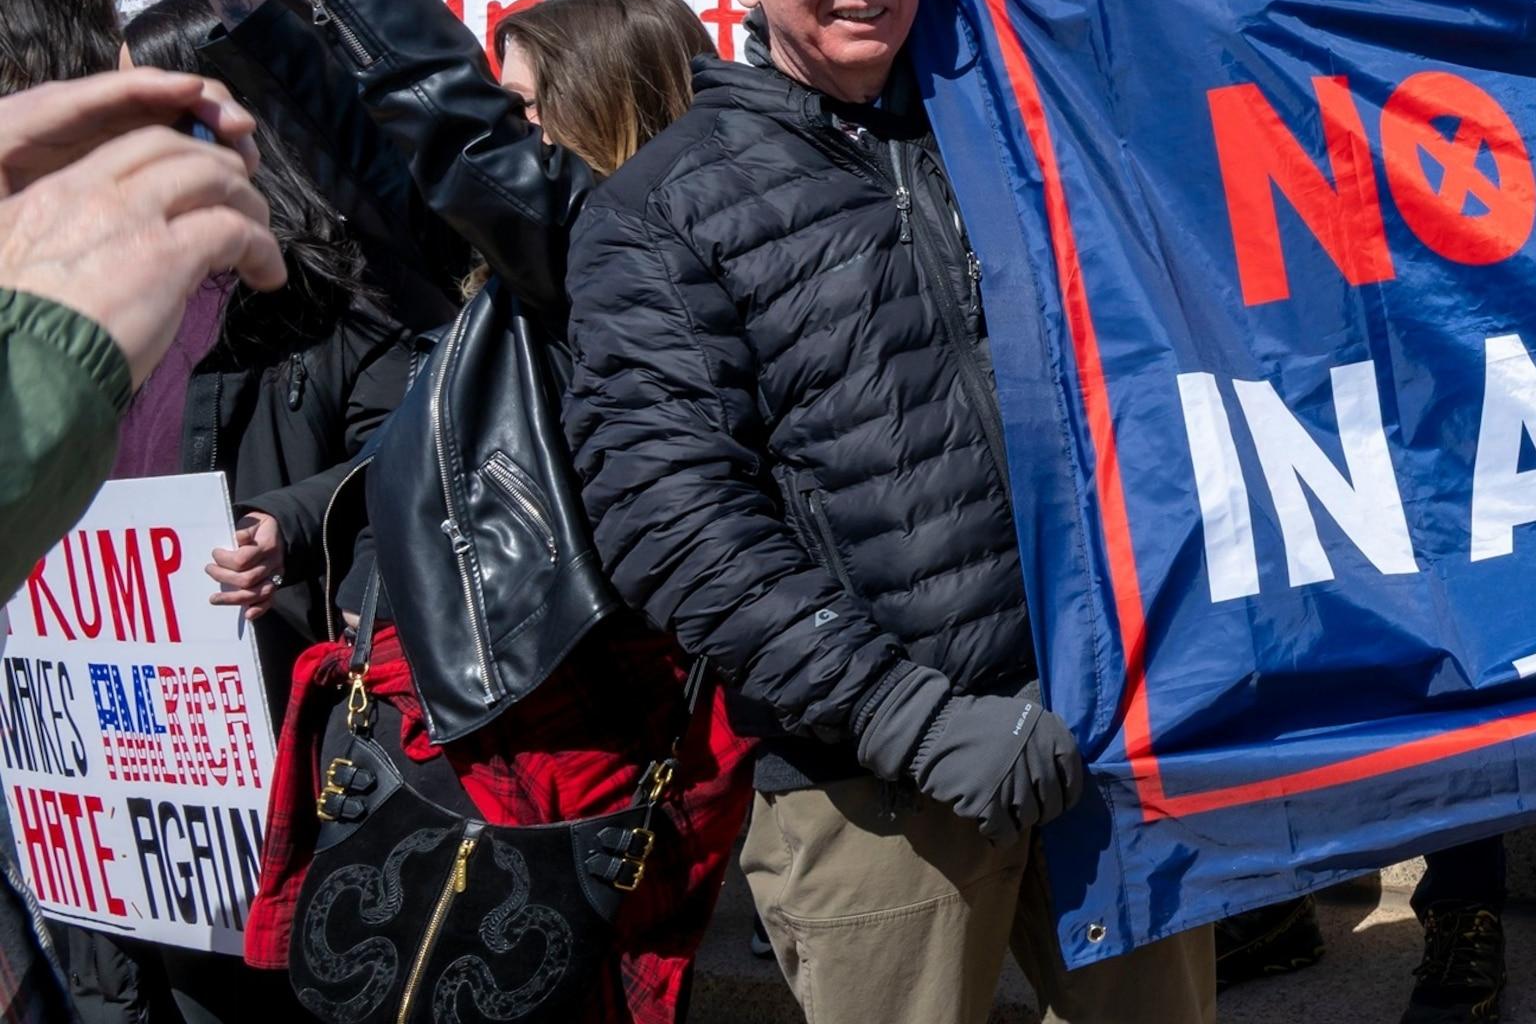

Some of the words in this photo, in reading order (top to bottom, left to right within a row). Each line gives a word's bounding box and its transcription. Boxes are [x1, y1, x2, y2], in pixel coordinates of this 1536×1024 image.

[1177, 360, 1419, 604] IN
[8, 527, 182, 644] RUMP
[88, 662, 262, 789] AMERICA
[1013, 703, 1032, 736] HEAD
[13, 785, 128, 917] HATE
[126, 797, 266, 932] AGAIN
